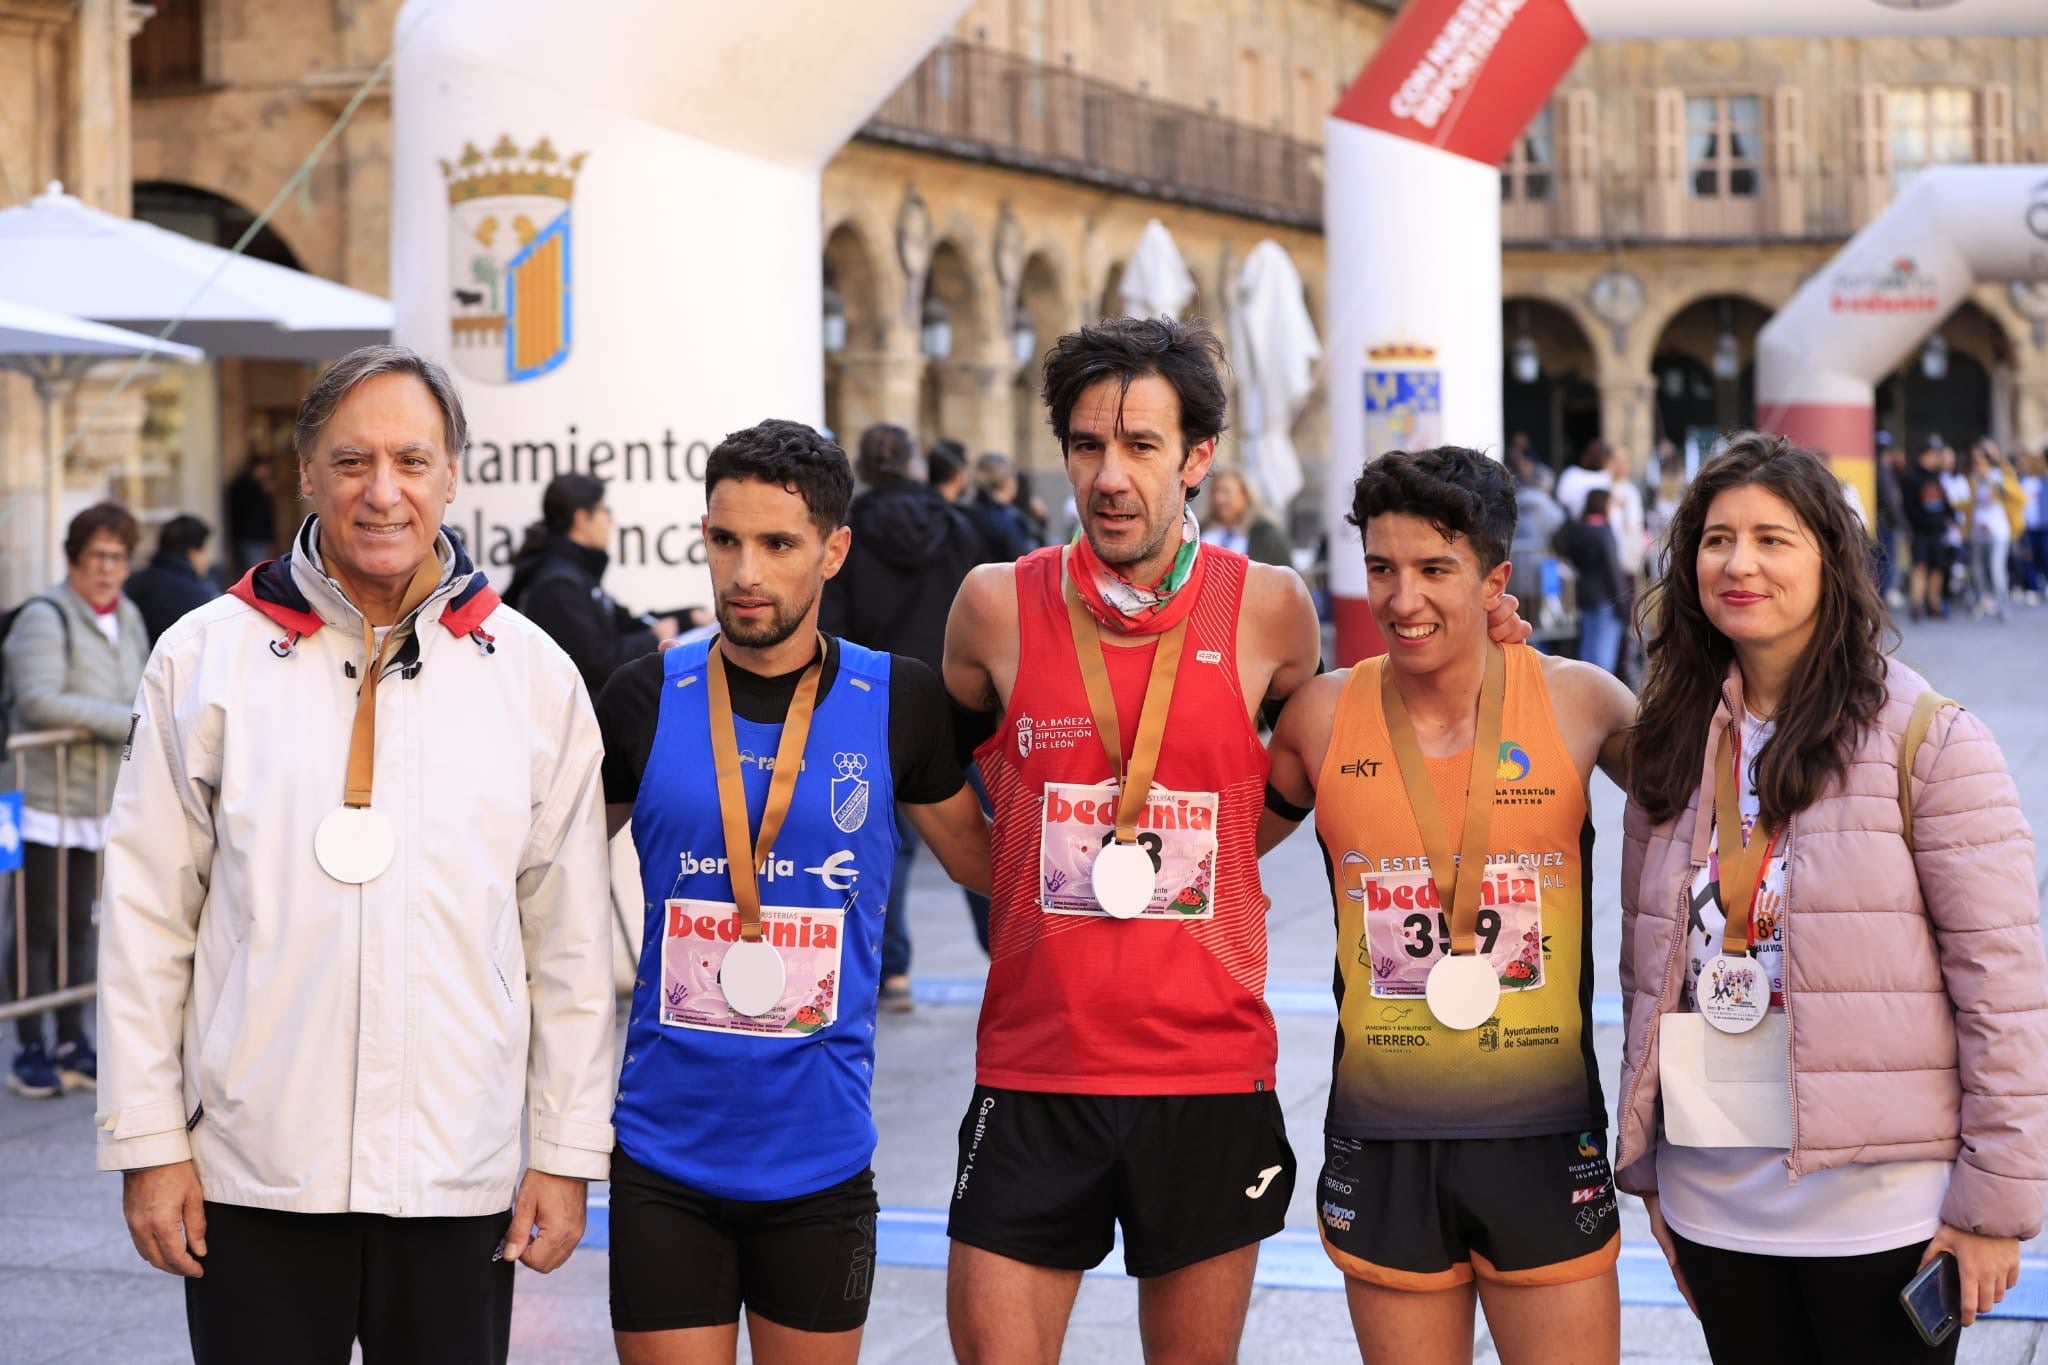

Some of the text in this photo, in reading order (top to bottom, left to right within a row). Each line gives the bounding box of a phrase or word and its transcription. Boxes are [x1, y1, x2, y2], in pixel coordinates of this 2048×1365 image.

[460, 426, 709, 484] tamiento
[1035, 716, 1092, 728] LA BAÑEZA
[1035, 729, 1092, 740] DIPUTACIÓN
[1035, 739, 1074, 750] DE LEÓN
[1341, 758, 1383, 778] EKT
[1493, 798, 1543, 806] MANTINA
[1102, 831, 1163, 875] 3
[679, 851, 794, 882] iberja
[1380, 856, 1431, 873] ESTE
[1366, 873, 1537, 912] bednia
[761, 911, 799, 920] RISTERÍAS
[668, 906, 837, 949] bednia
[1503, 1025, 1560, 1039] Ayuntamiento
[1367, 1034, 1426, 1047] HERRERO
[1504, 1036, 1560, 1049] de Salamanca
[956, 1097, 995, 1200] Castilla y León
